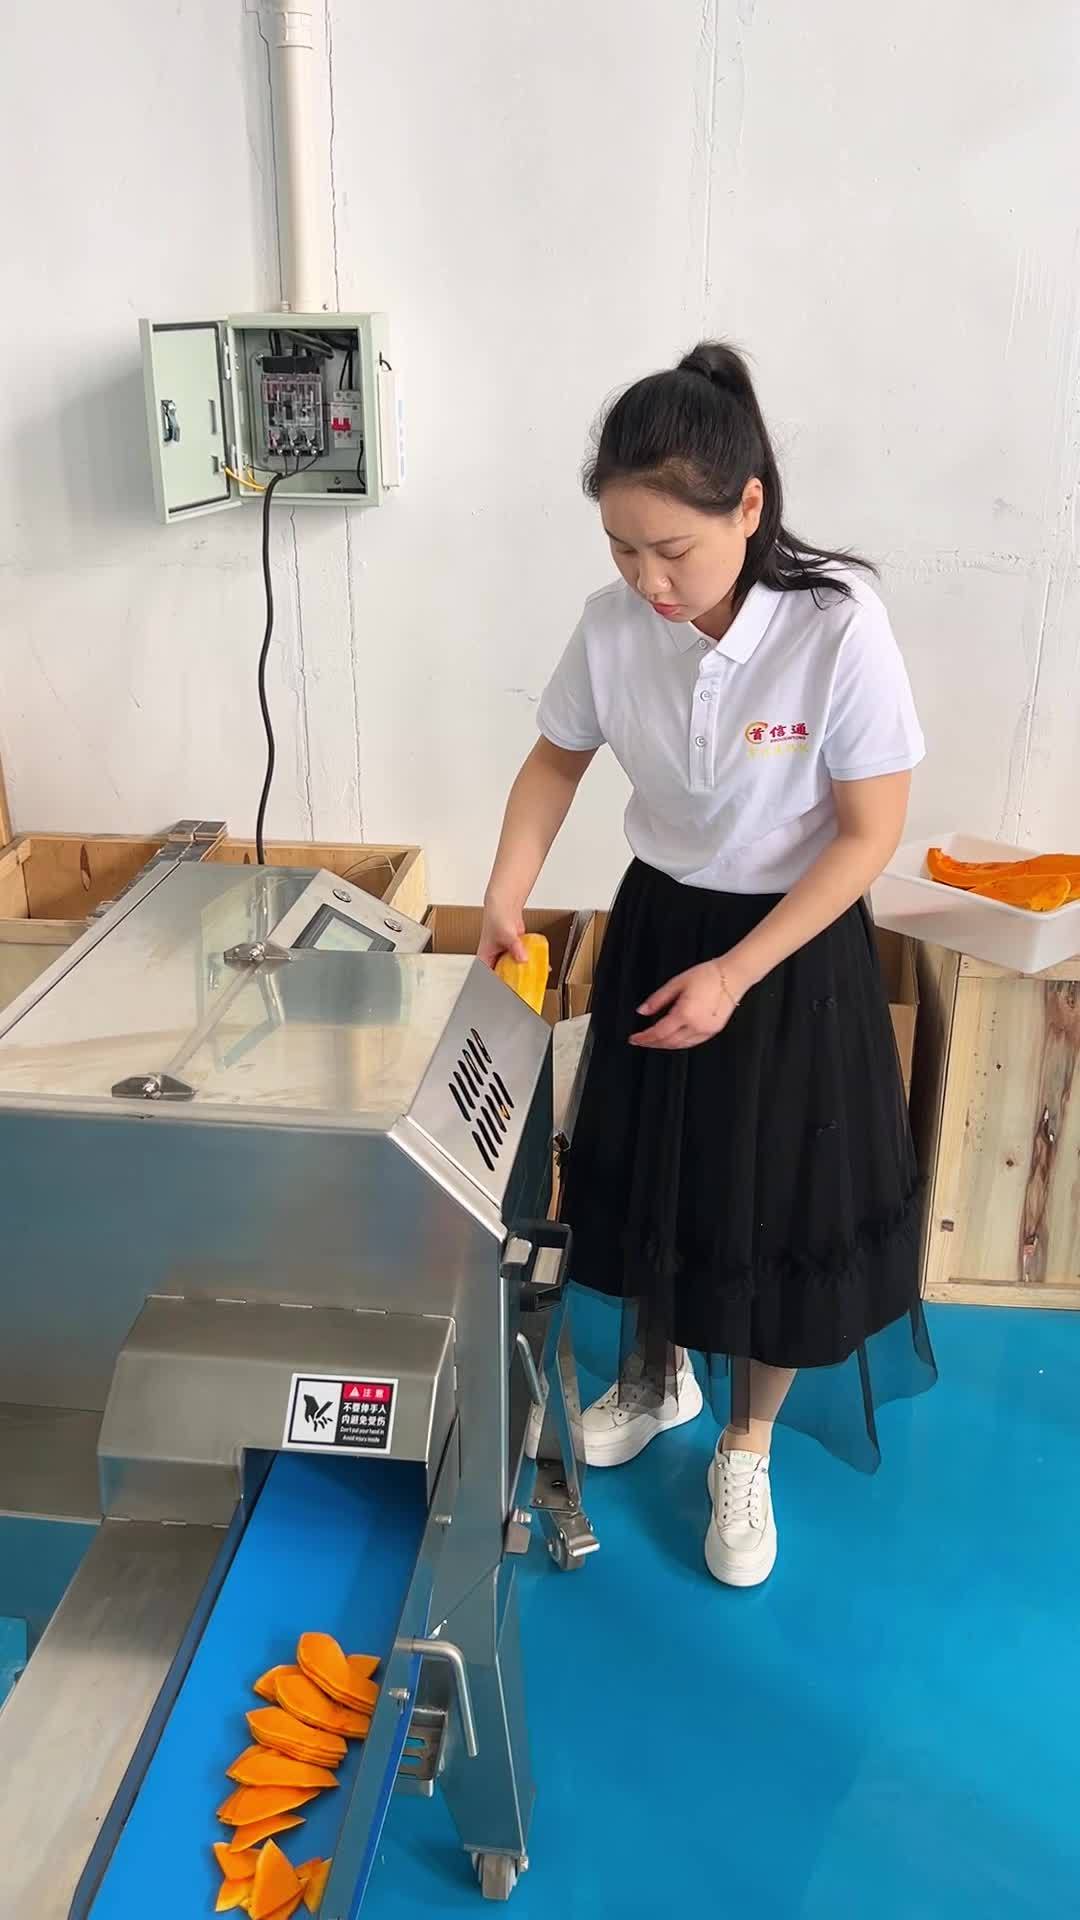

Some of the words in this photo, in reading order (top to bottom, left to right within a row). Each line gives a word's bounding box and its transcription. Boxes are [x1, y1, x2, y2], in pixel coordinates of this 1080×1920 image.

[749, 722, 810, 741] 首信通
[362, 1388, 384, 1398] 注意
[341, 1414, 386, 1426] 内避免受伤
